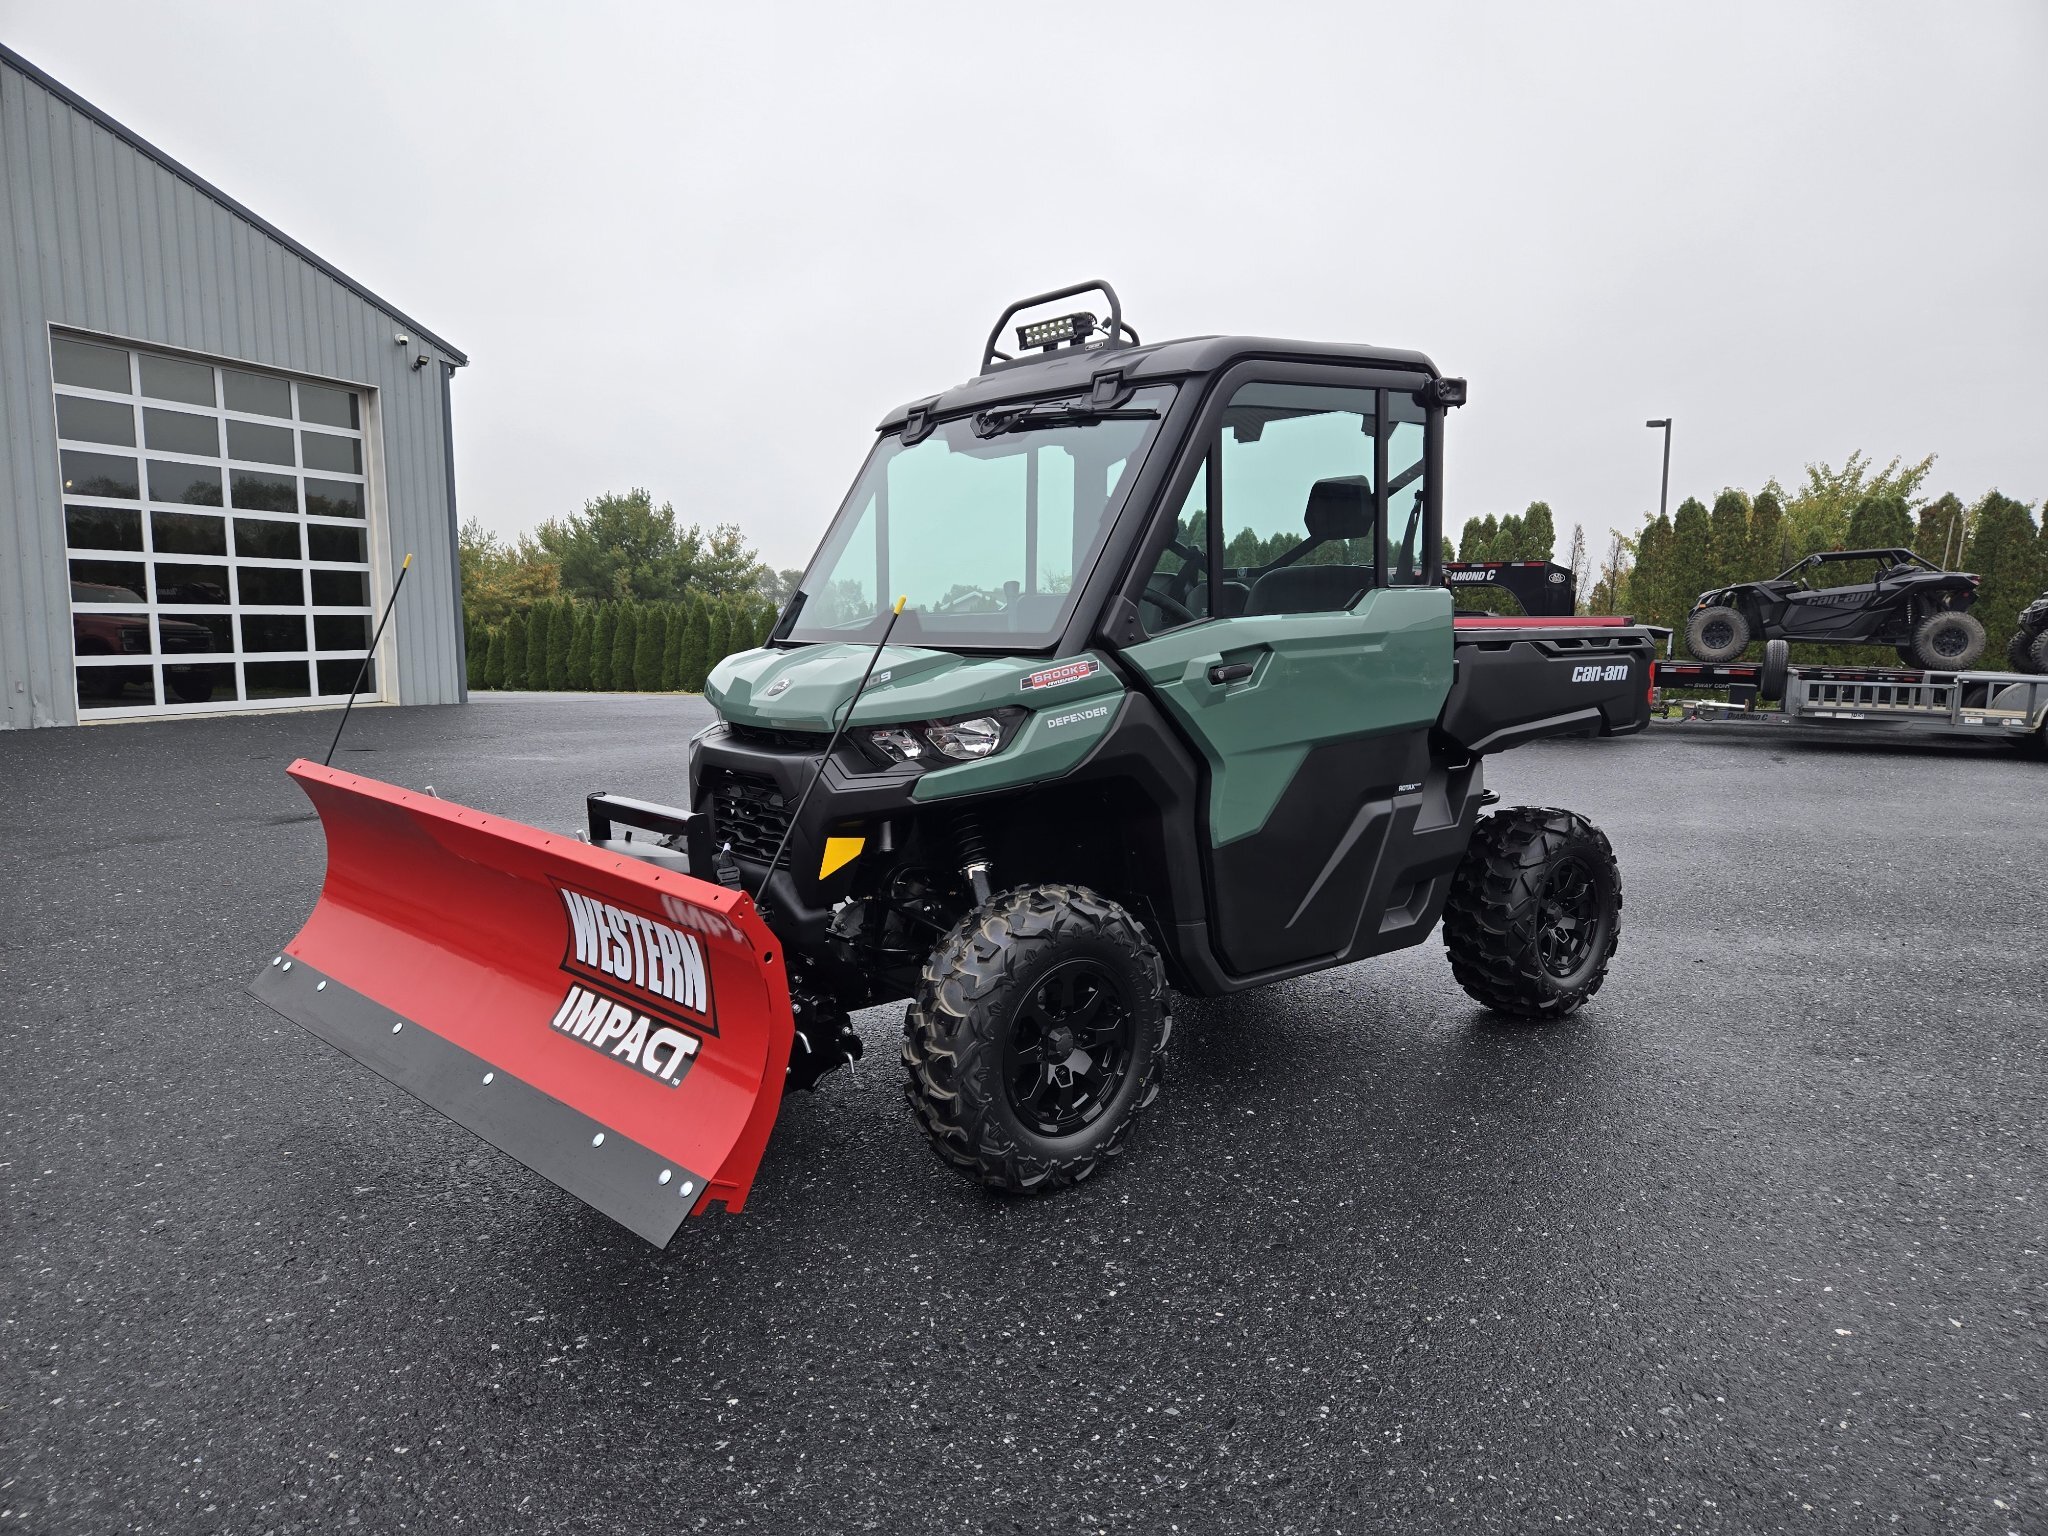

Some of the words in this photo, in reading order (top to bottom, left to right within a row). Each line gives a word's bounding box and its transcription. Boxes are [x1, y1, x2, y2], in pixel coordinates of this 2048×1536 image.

[1451, 571, 1486, 581] AMOND
[1486, 569, 1497, 581] C
[1034, 664, 1088, 684] BROOKS
[1572, 665, 1628, 683] can-am
[1047, 706, 1108, 729] DEFENDER
[1761, 713, 1769, 721] C
[560, 887, 707, 1014] WESTERN
[552, 986, 700, 1080] IMPACT
